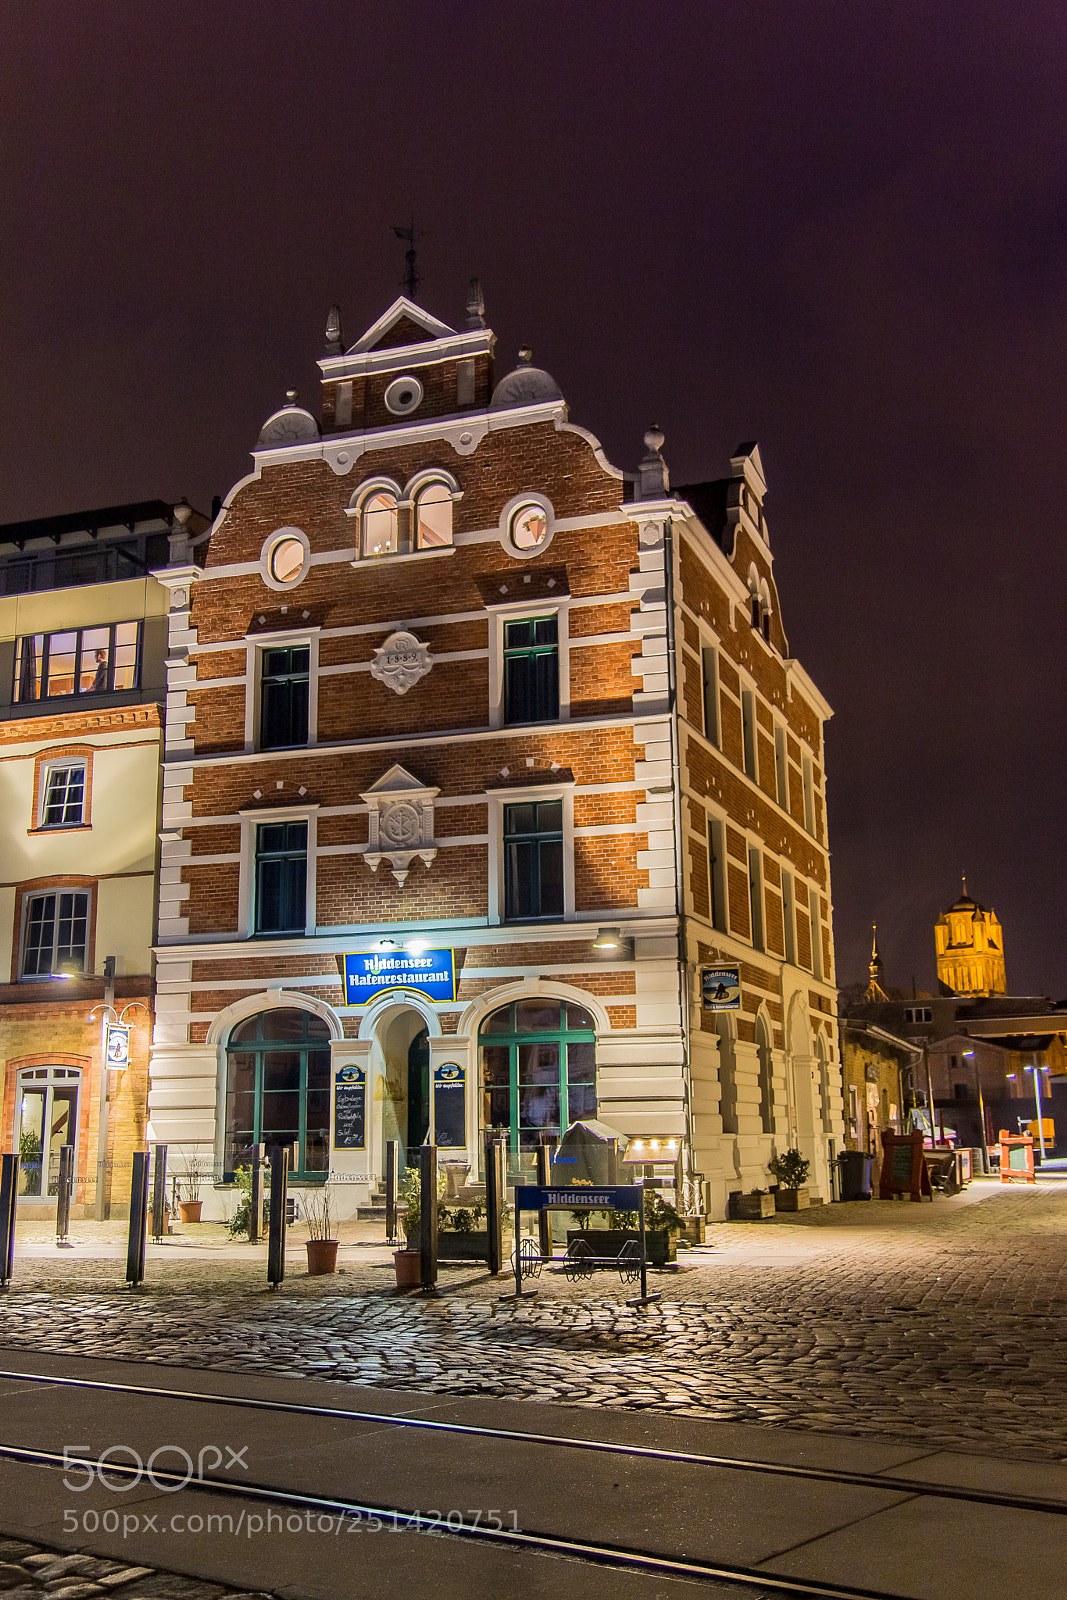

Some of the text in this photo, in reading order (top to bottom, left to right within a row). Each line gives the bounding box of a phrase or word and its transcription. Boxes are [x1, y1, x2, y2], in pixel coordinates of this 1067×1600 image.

[364, 954, 433, 972] Hiddenseer
[349, 971, 450, 986] Hafenrestaurant
[547, 1192, 610, 1204] Hiddenseer
